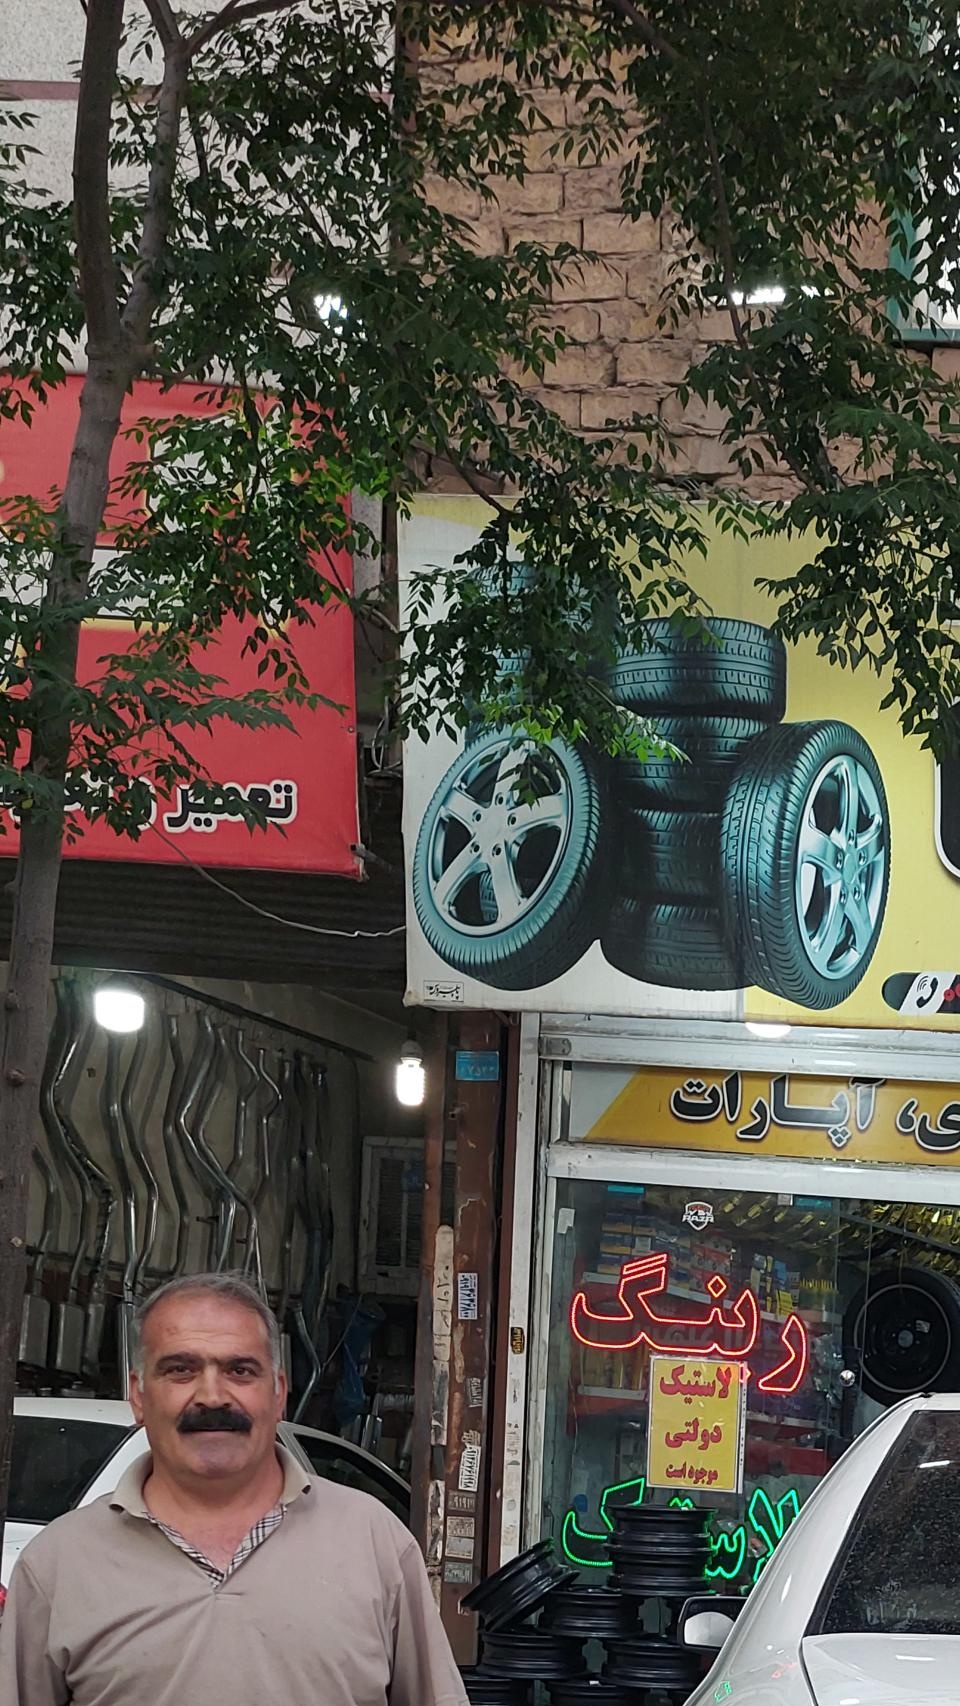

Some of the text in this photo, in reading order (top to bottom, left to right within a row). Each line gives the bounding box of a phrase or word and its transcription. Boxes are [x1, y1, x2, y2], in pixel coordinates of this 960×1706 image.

[670, 1071, 888, 1148] آپارات
[571, 1252, 807, 1393] رینگ
[659, 1364, 732, 1404] لاستیک
[664, 1417, 723, 1451] دولتی
[665, 1460, 719, 1486] موجود است
